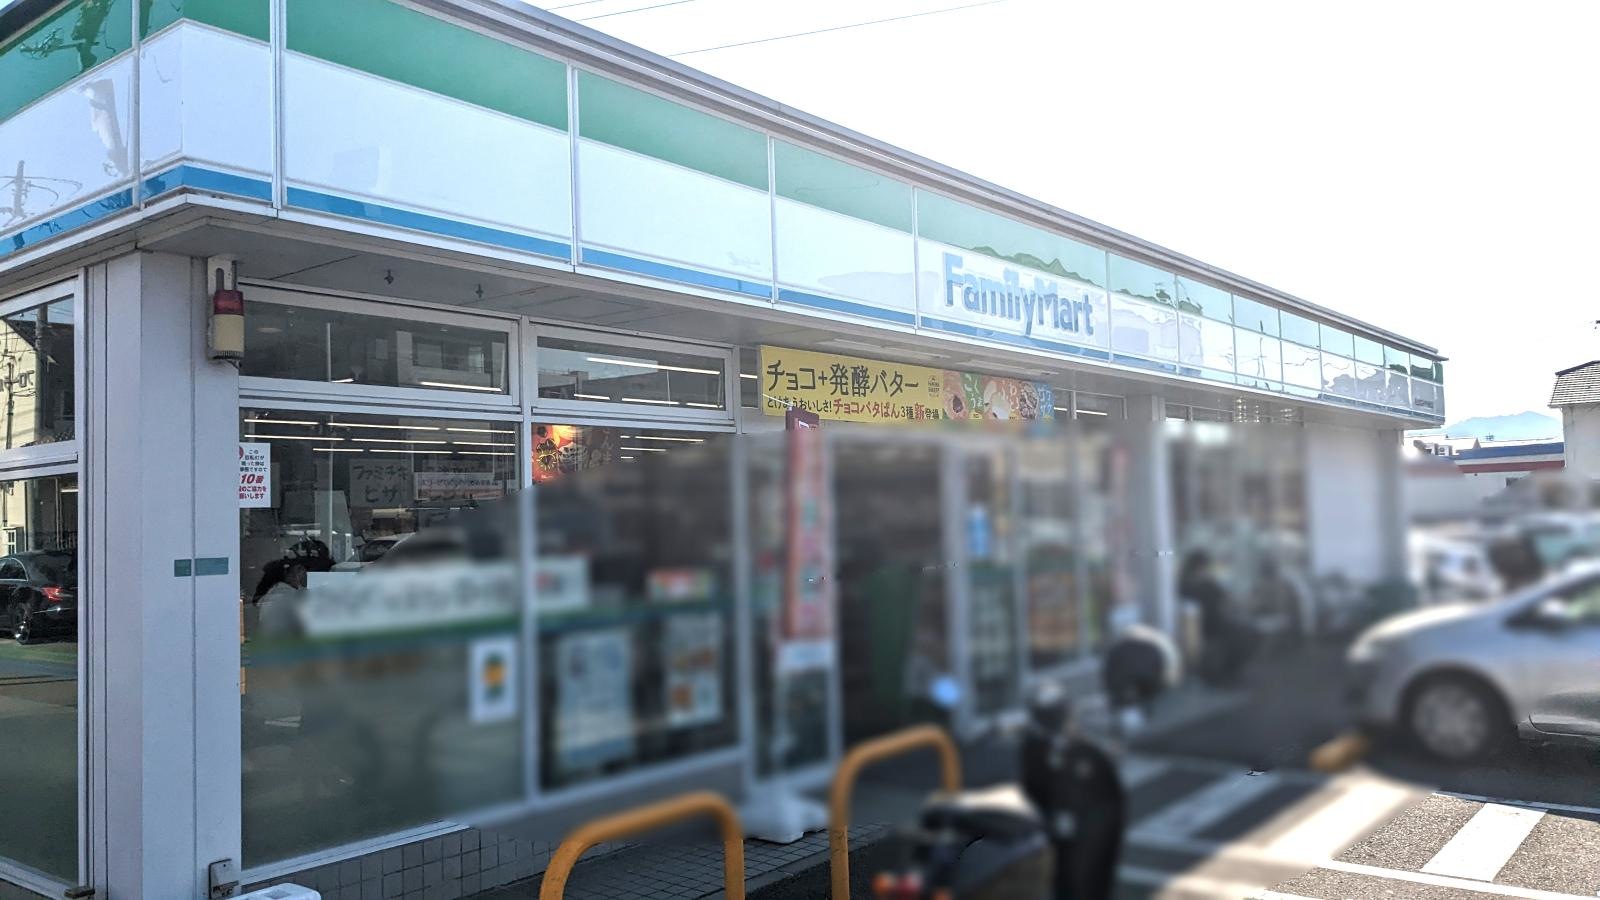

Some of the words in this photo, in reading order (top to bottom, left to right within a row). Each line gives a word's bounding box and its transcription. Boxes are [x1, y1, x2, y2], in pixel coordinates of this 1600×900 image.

[944, 251, 1094, 336] FamilyMart
[766, 359, 919, 398] チョコ+発酵バター
